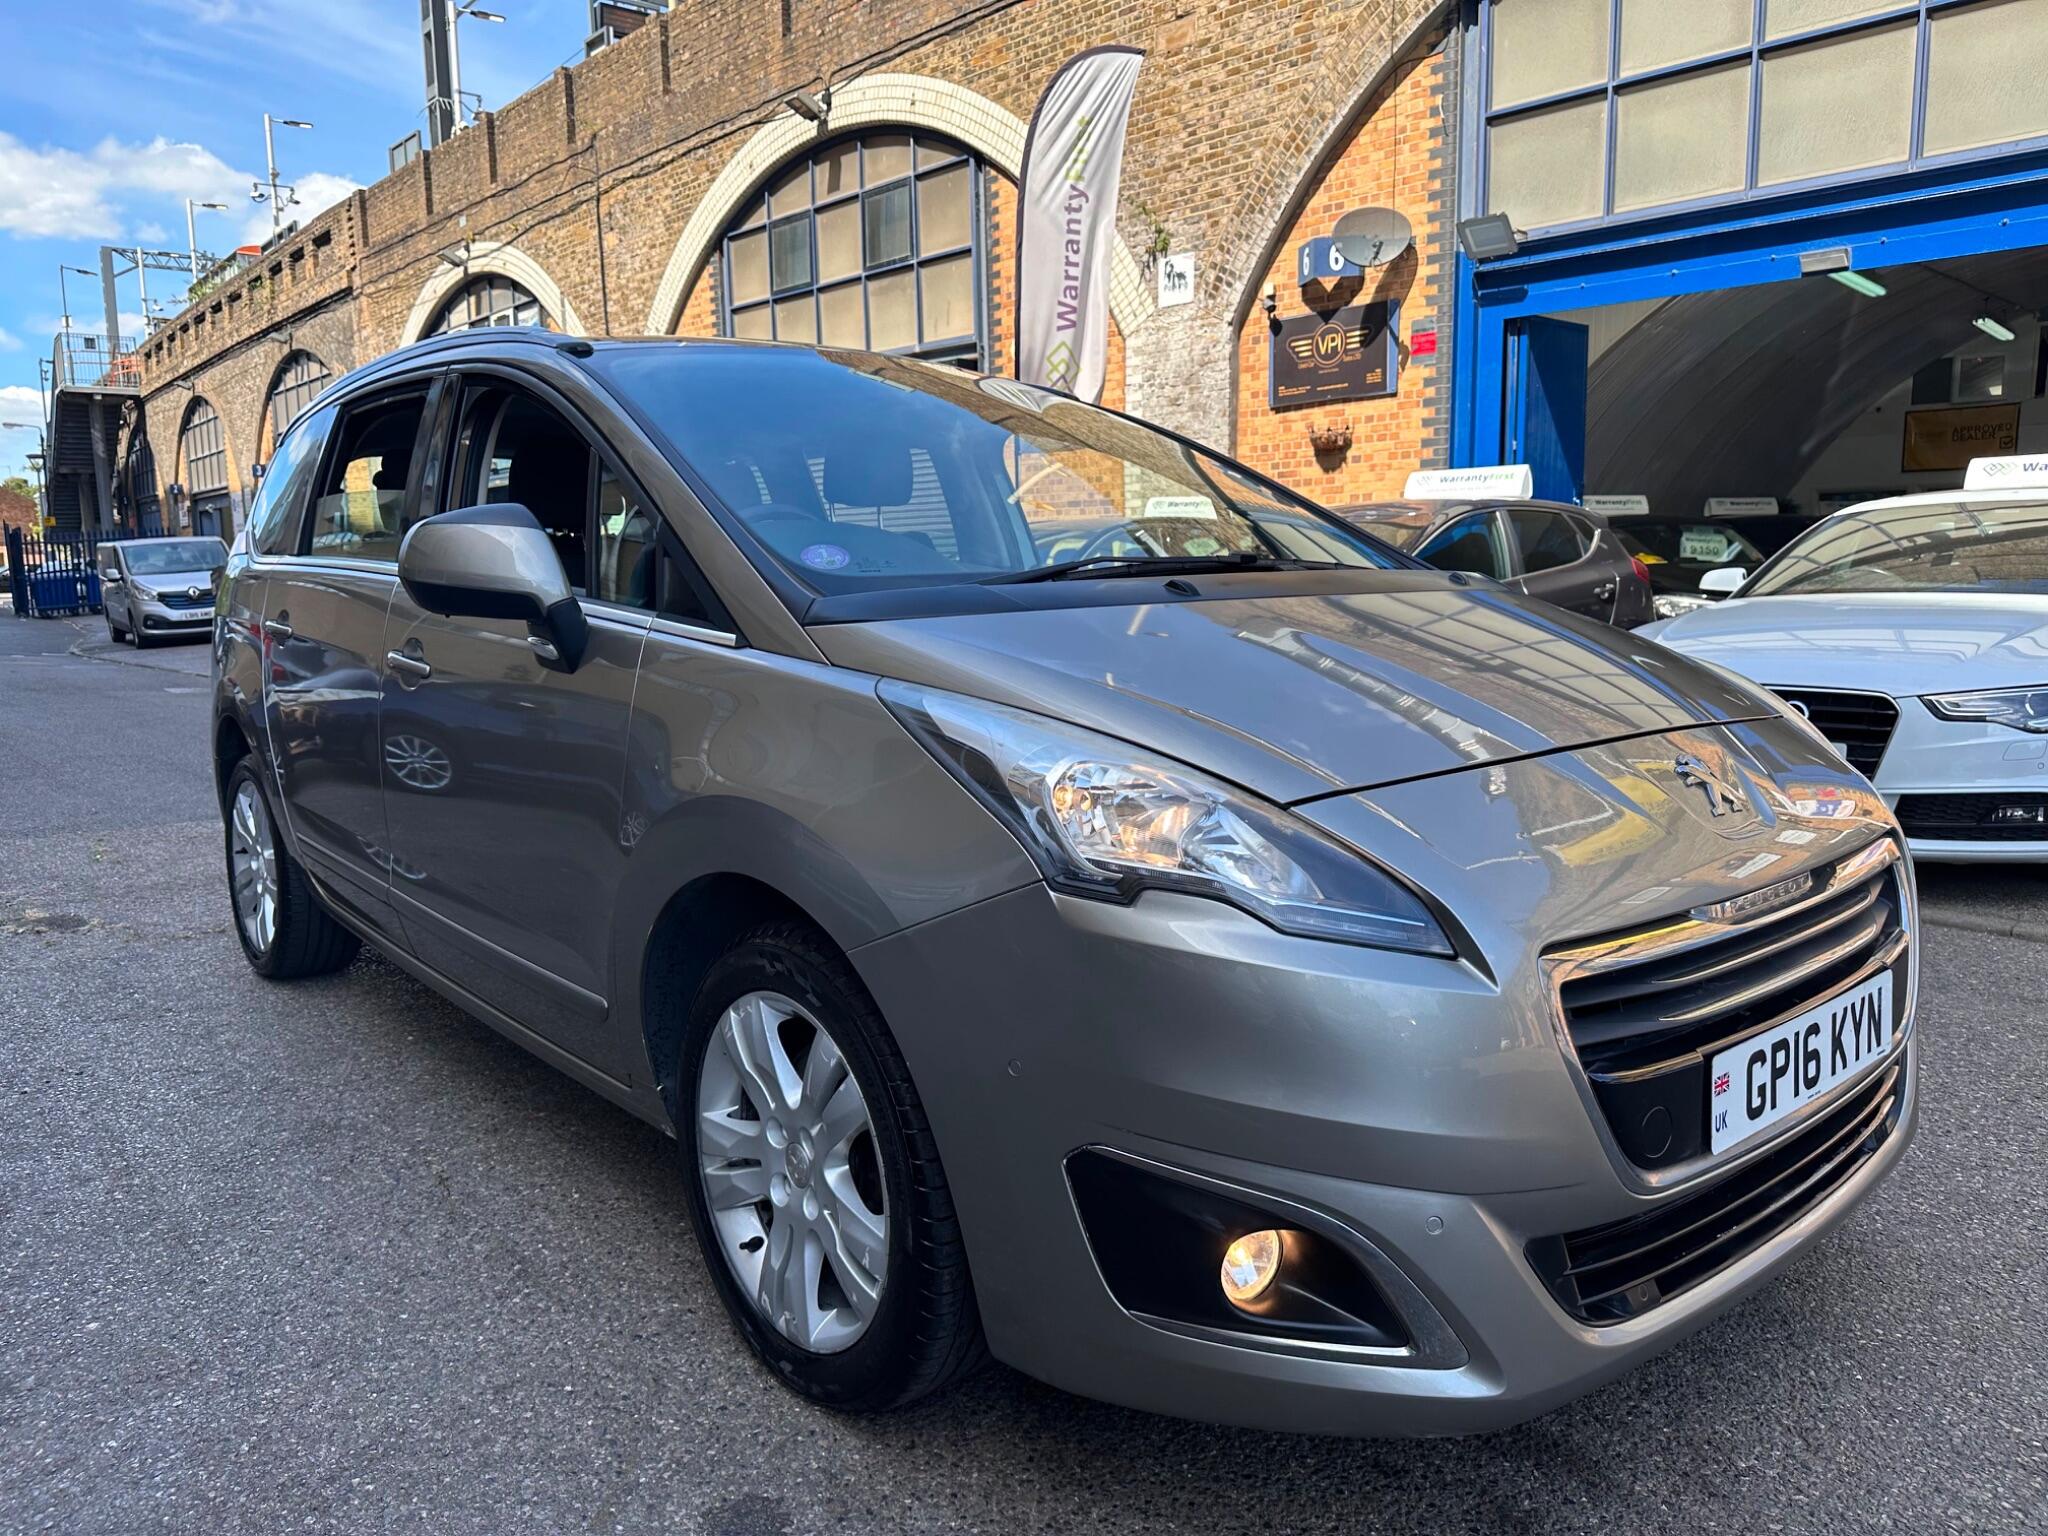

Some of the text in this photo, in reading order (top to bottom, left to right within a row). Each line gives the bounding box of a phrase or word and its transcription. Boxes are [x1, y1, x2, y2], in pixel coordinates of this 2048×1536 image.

[1056, 115, 1089, 332] WarrantyFirt
[1303, 247, 1310, 275] 6
[1329, 244, 1345, 271] 6
[1317, 333, 1342, 355] VPI
[1951, 431, 1996, 442] DEALER
[1952, 422, 2013, 434] APPROVED
[1439, 472, 1515, 484] WarrantyFirst
[1731, 877, 1807, 914] PEUGEOT
[1746, 986, 1883, 1121] GP16 KYN
[1715, 1110, 1728, 1133] UK
